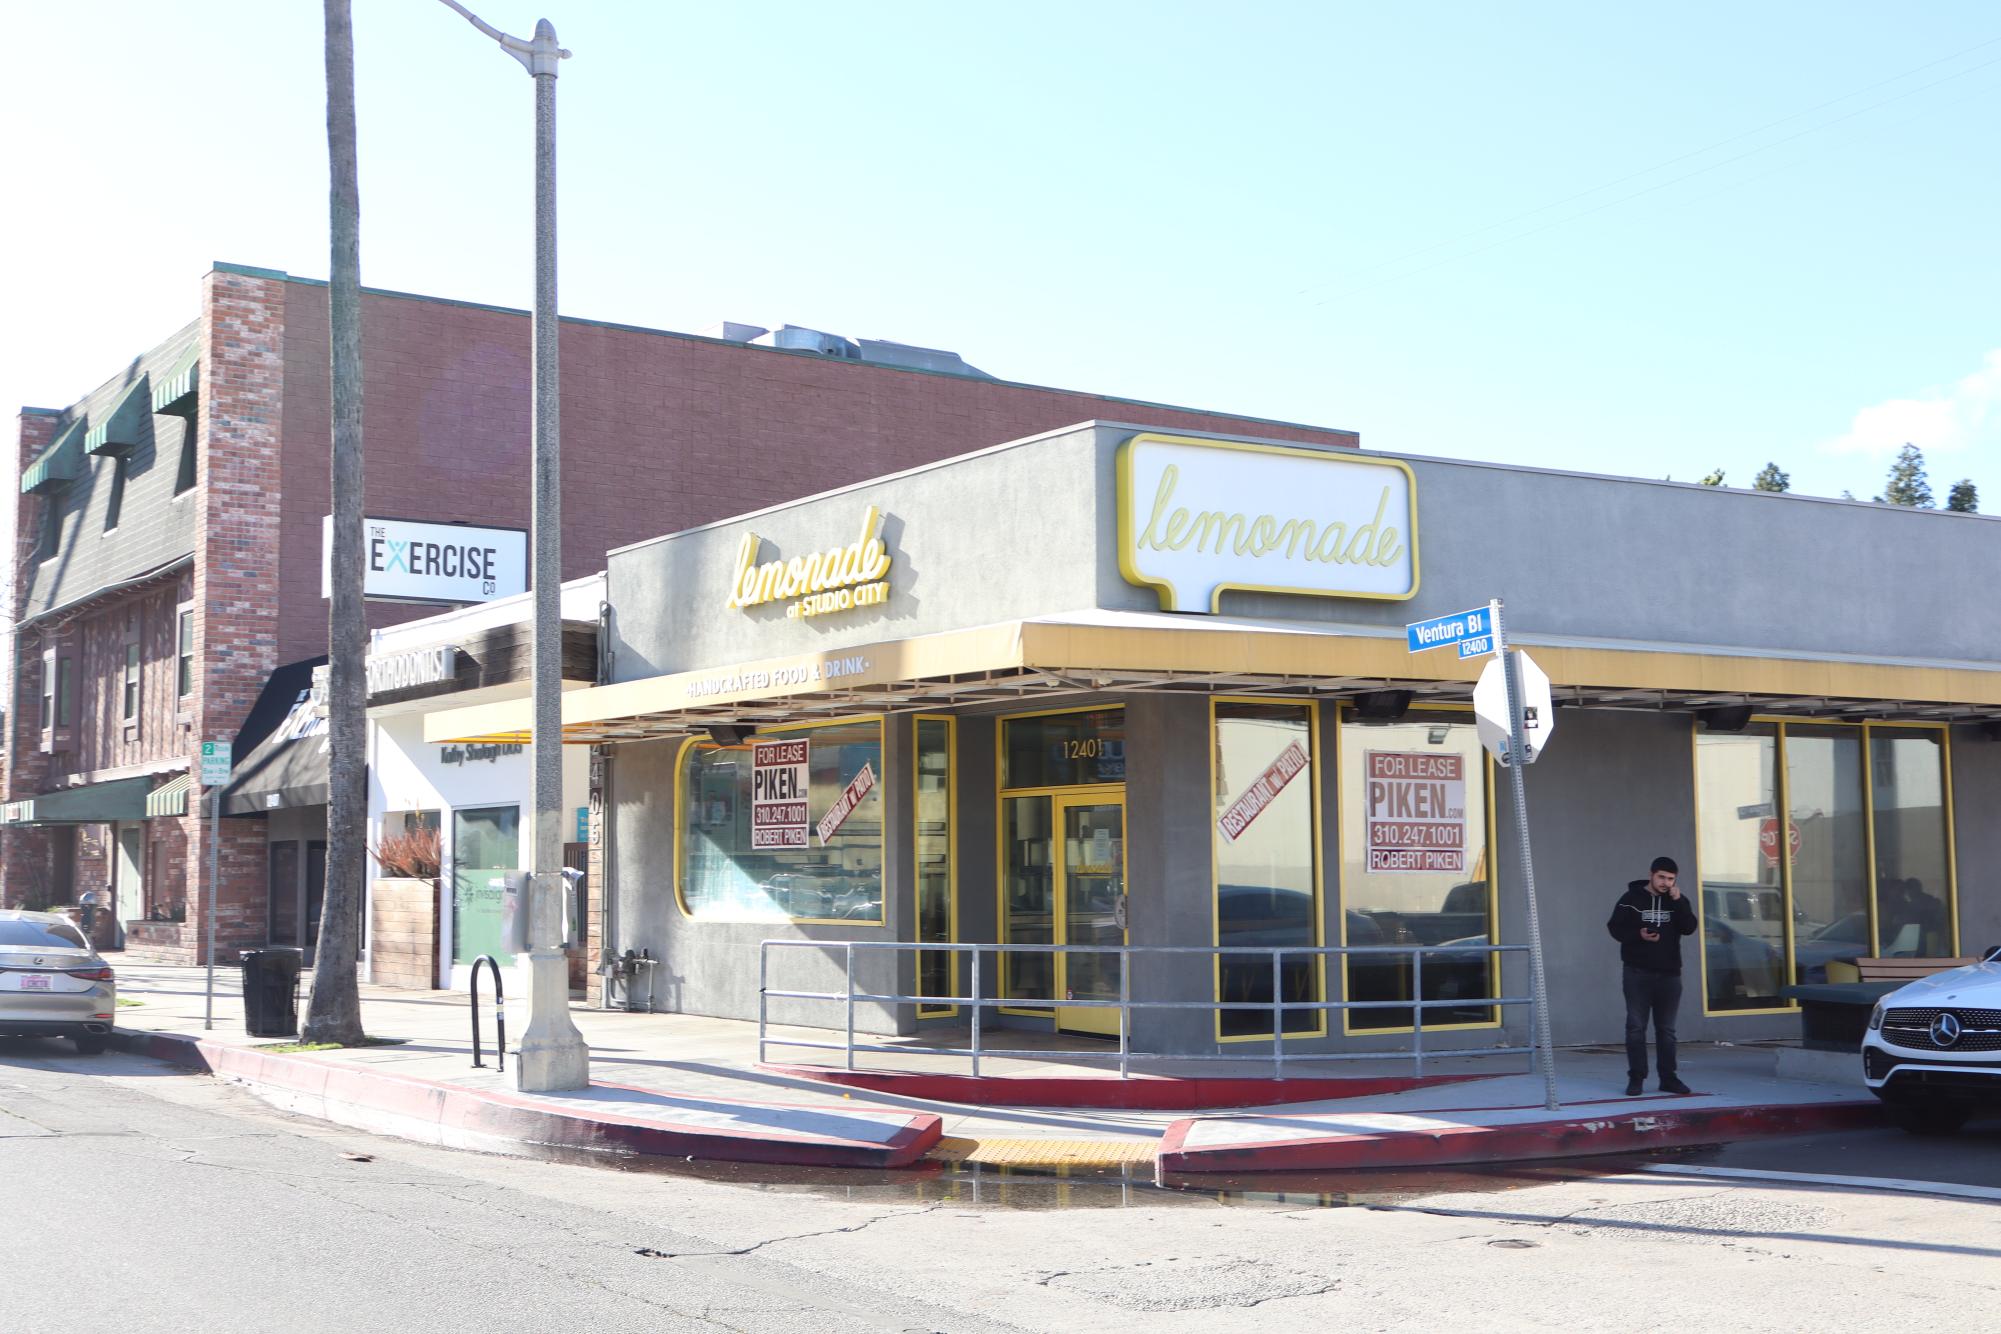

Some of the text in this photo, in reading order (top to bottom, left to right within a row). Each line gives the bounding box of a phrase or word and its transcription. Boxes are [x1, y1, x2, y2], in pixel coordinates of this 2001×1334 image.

[1138, 463, 1405, 567] lemonade
[370, 526, 386, 538] THE
[371, 539, 497, 580] EXERCISE
[726, 505, 892, 609] lemonade
[786, 581, 890, 618] at STUDIO CITY
[1416, 613, 1483, 645] Ventura Bl
[1462, 638, 1488, 655] 12400
[688, 671, 770, 698] HANDCRAFTED
[774, 666, 808, 687] FOOD
[824, 656, 864, 679] DRINK
[204, 744, 213, 754] 2
[757, 744, 804, 764] FOR LEASE
[1063, 739, 1104, 759] 12401
[1375, 757, 1456, 777] FOR LEASE
[1222, 776, 1276, 837] RESTAURANT
[1276, 746, 1306, 780] PATIO
[756, 806, 806, 823] 310.247.1001
[820, 792, 852, 841] RESTAURANT
[855, 768, 873, 798] PATIO
[755, 828, 807, 845] ROBERT PIKEN
[1374, 825, 1460, 844] 310.247.1001
[1373, 852, 1461, 869] ROBERT PIKEN
